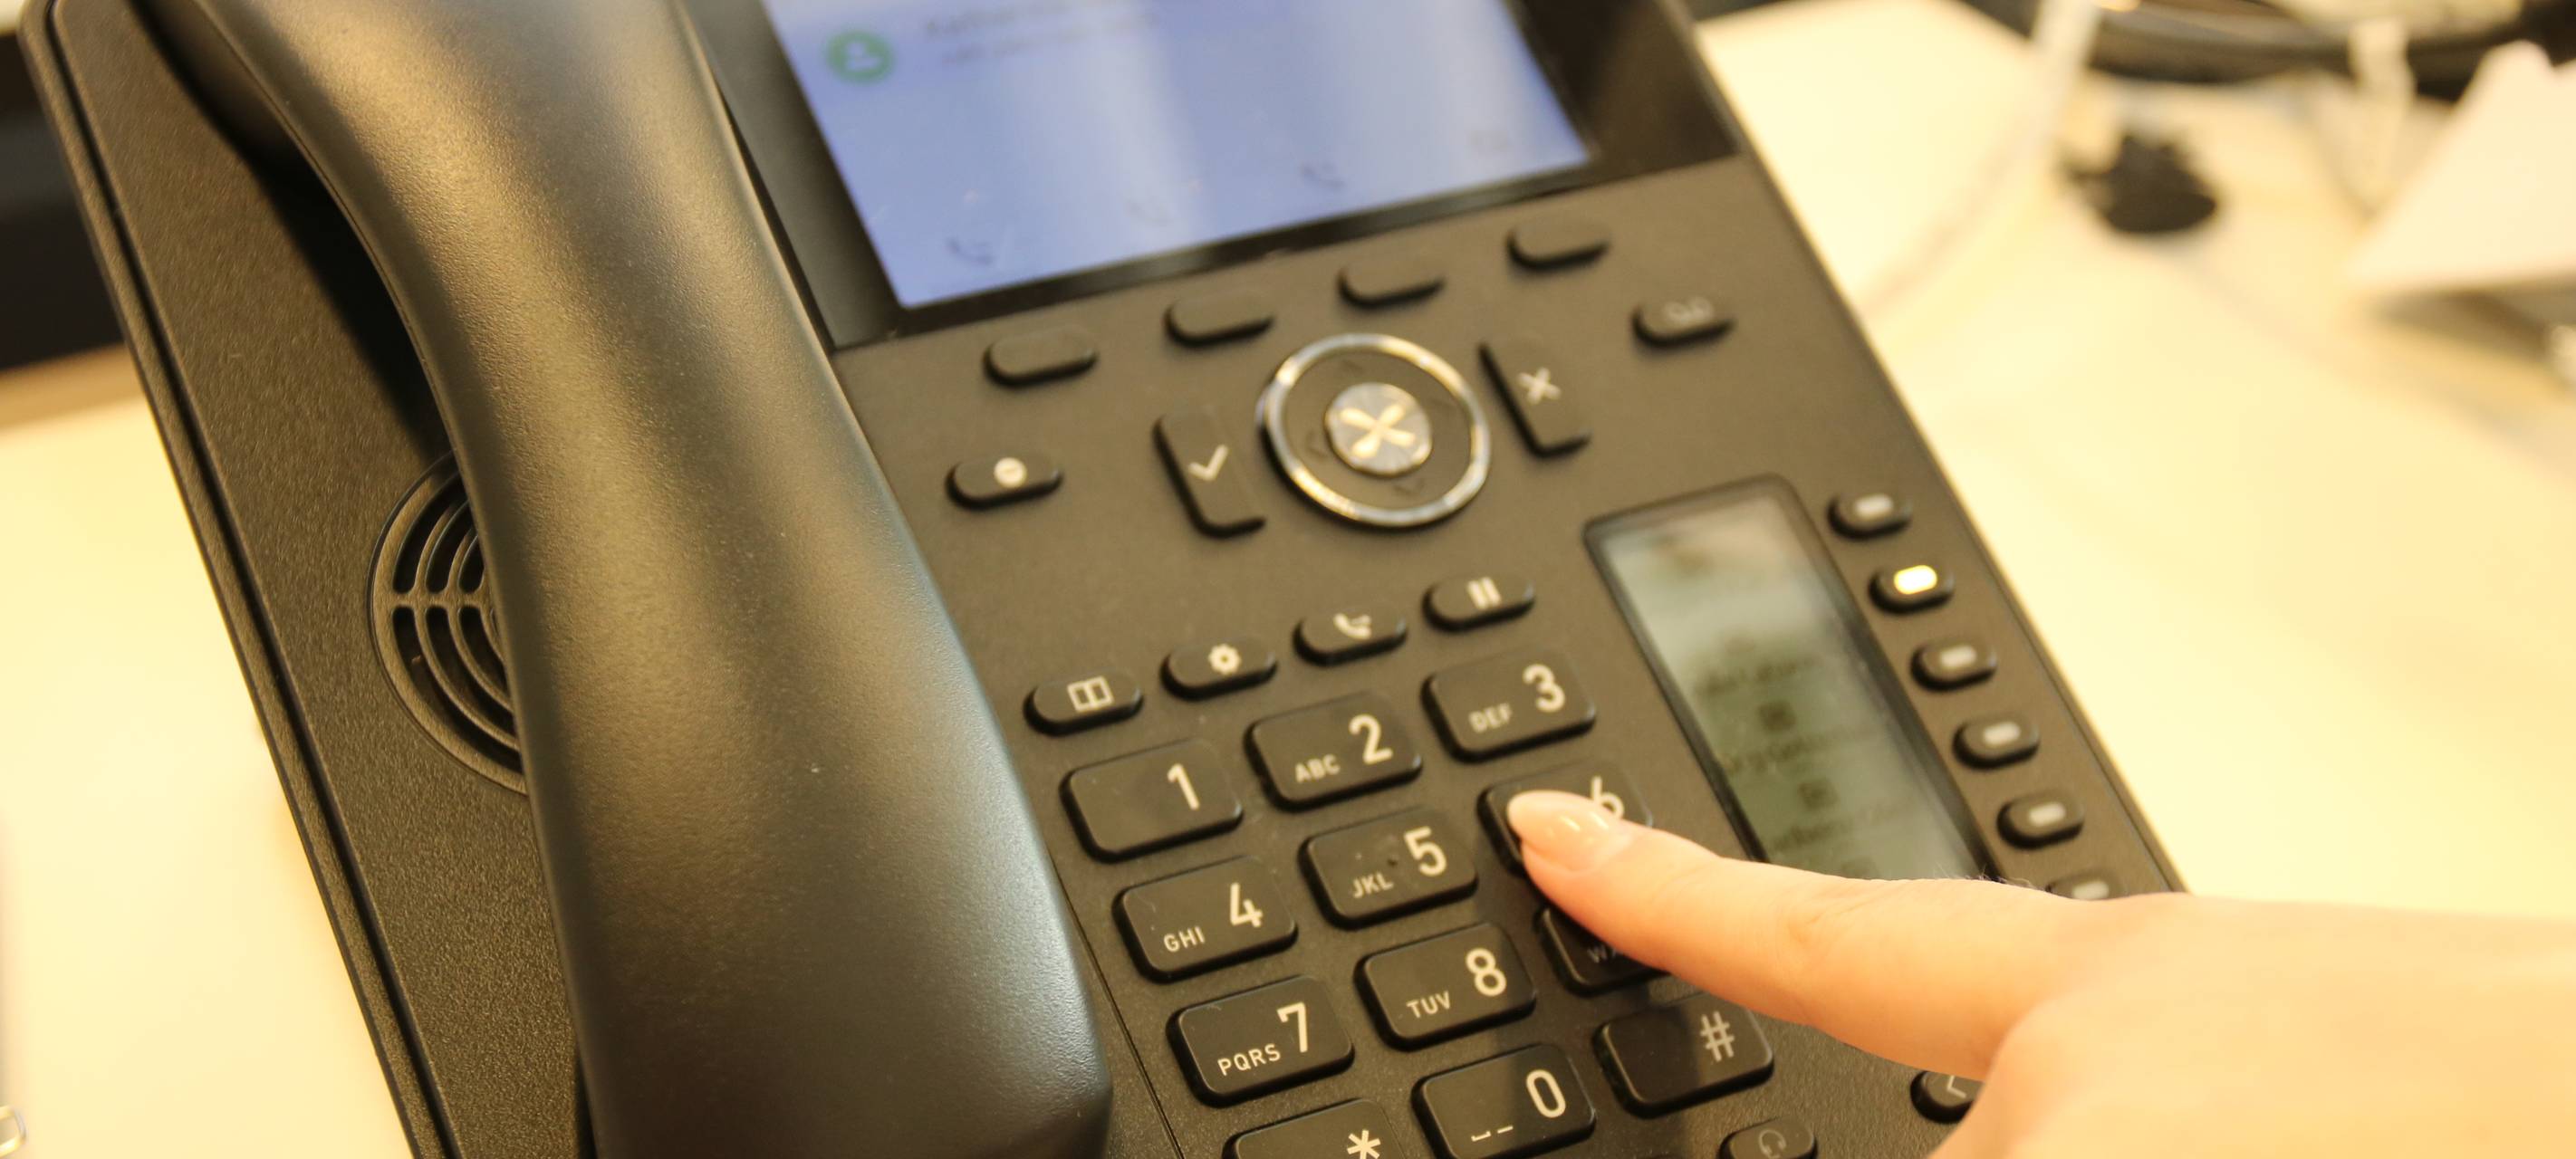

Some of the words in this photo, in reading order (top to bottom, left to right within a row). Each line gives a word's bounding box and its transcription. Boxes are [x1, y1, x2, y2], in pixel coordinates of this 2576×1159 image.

[1469, 704, 1512, 733] DEF
[1523, 664, 1565, 712] 3
[1295, 754, 1340, 782] ABC
[1349, 714, 1392, 764] 2
[1168, 763, 1199, 809] 1
[1353, 873, 1393, 898] JKL
[1404, 827, 1447, 876] 5
[1163, 926, 1206, 953] GHI
[1229, 883, 1263, 927] 4
[1406, 991, 1451, 1019] TUV
[1466, 948, 1506, 997] 8
[1217, 1043, 1282, 1077] PQRS
[1277, 1001, 1308, 1053] 7
[1525, 1069, 1566, 1118] 0
